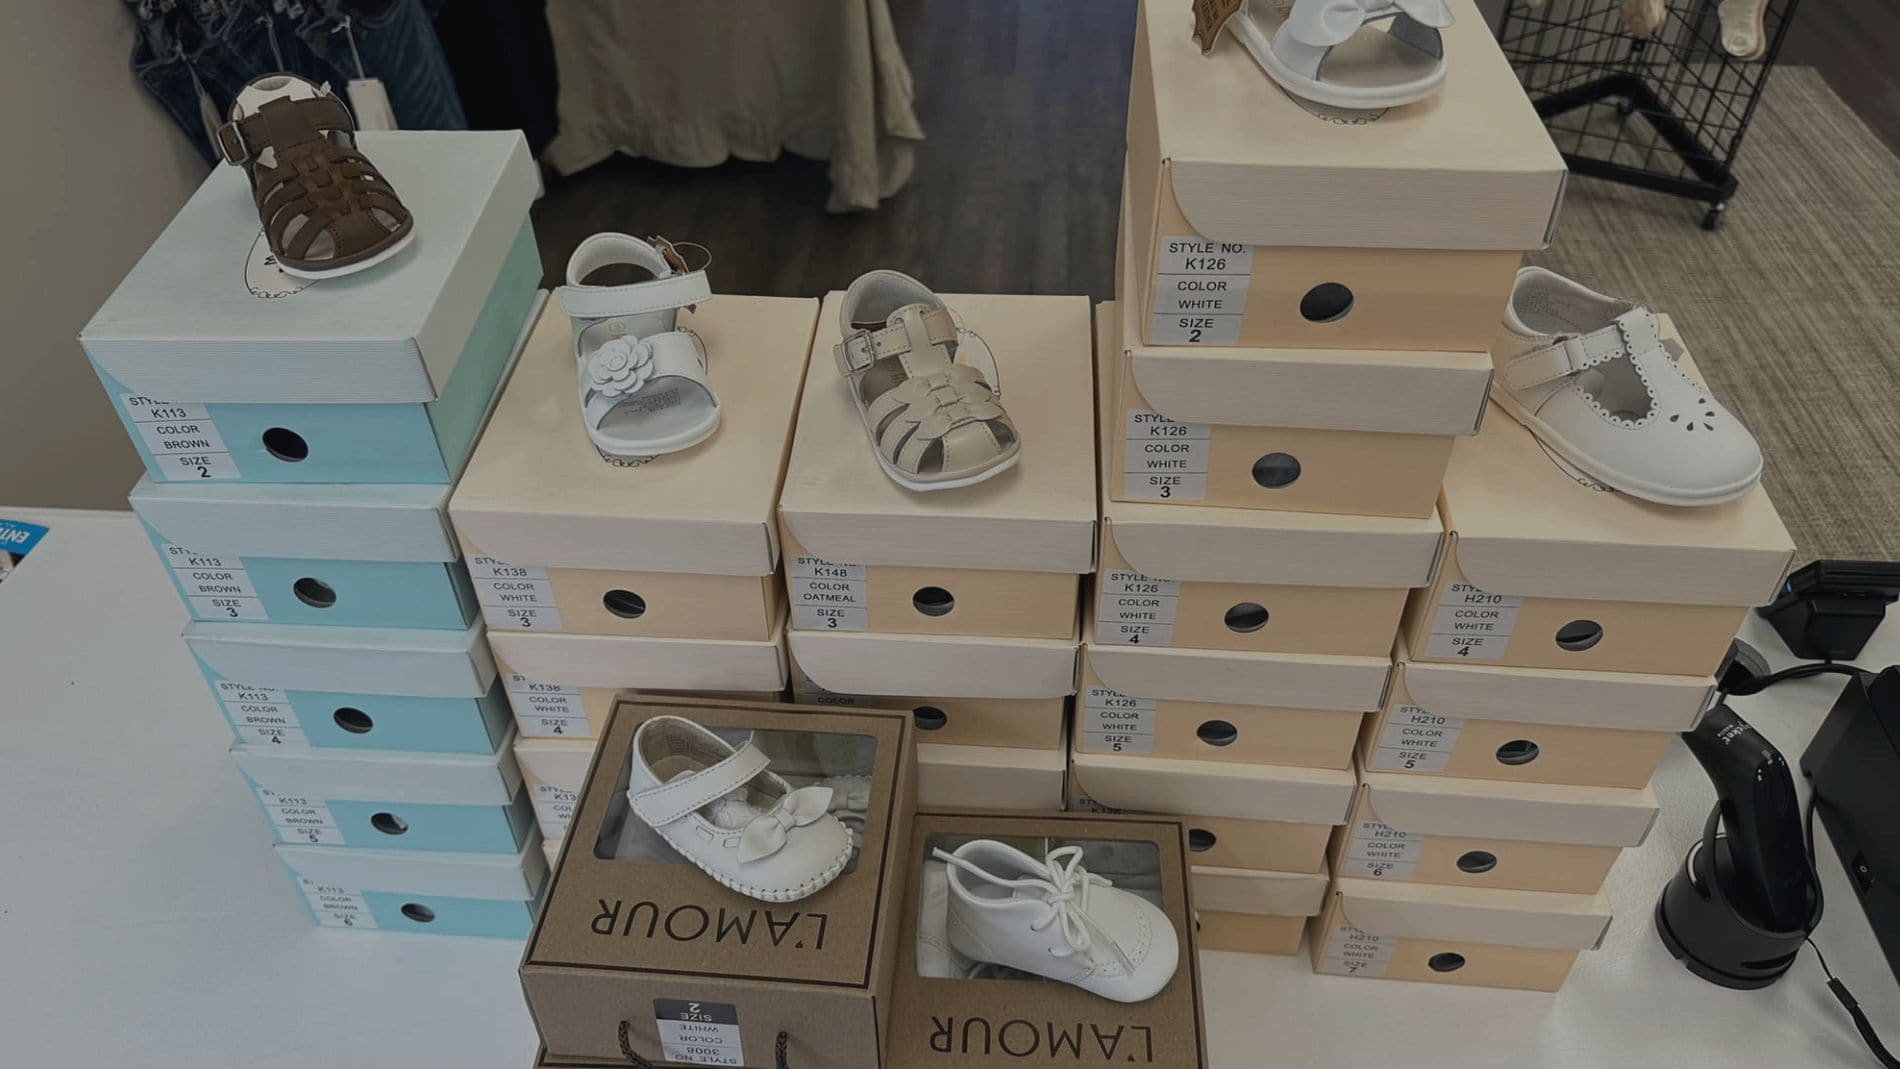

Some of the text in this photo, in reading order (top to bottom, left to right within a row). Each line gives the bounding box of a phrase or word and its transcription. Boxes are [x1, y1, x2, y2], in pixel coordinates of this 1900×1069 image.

[1169, 243, 1246, 253] STYLE NO.
[1186, 258, 1226, 270] K126
[1178, 281, 1227, 291] COLOR
[1178, 300, 1222, 309] WHITE
[1179, 319, 1214, 328] SIZE
[1189, 330, 1201, 342] 2
[129, 397, 169, 406] STY
[152, 408, 186, 418] K113
[157, 425, 200, 435] COLOR
[1150, 426, 1187, 436] K126
[164, 440, 210, 449] BROWN
[1145, 445, 1189, 453] COLOR
[180, 456, 211, 465] SIZE
[1147, 460, 1187, 468] WHITE
[198, 467, 211, 478] 2
[1150, 477, 1181, 485] SIZE
[1160, 486, 1170, 498] 3
[189, 558, 221, 566] K113
[193, 572, 233, 580] COLOR
[493, 568, 527, 576] K138
[815, 568, 847, 577] K148
[810, 582, 849, 591] COLOR
[1125, 584, 1158, 592] K126
[500, 594, 537, 602] WHITE
[803, 593, 856, 602] OATMEAL
[1464, 595, 1502, 603] H210
[212, 599, 241, 607] SIZE
[1119, 599, 1159, 607] COLOR
[226, 608, 238, 617] 3
[508, 609, 536, 617] SIZE
[817, 609, 845, 617] SIZE
[1455, 610, 1499, 618] COLOR
[520, 618, 531, 627] 3
[828, 618, 837, 628] 3
[1120, 626, 1149, 634] SIZE
[1129, 635, 1139, 643] 4
[1457, 647, 1469, 656] 4
[241, 705, 278, 713] COLOR
[1411, 716, 1445, 725] H210
[553, 726, 563, 734] 4
[1402, 728, 1443, 737] COLOR
[272, 736, 281, 744] 4
[1401, 739, 1438, 747] WHITE
[1113, 743, 1122, 751] 5
[1399, 752, 1428, 760] SIZE
[1404, 760, 1416, 768] 5
[688, 1002, 700, 1013] 2
[680, 1013, 712, 1021] SIZE
[680, 1024, 719, 1032] WHITE
[680, 1035, 722, 1044] COLOR
